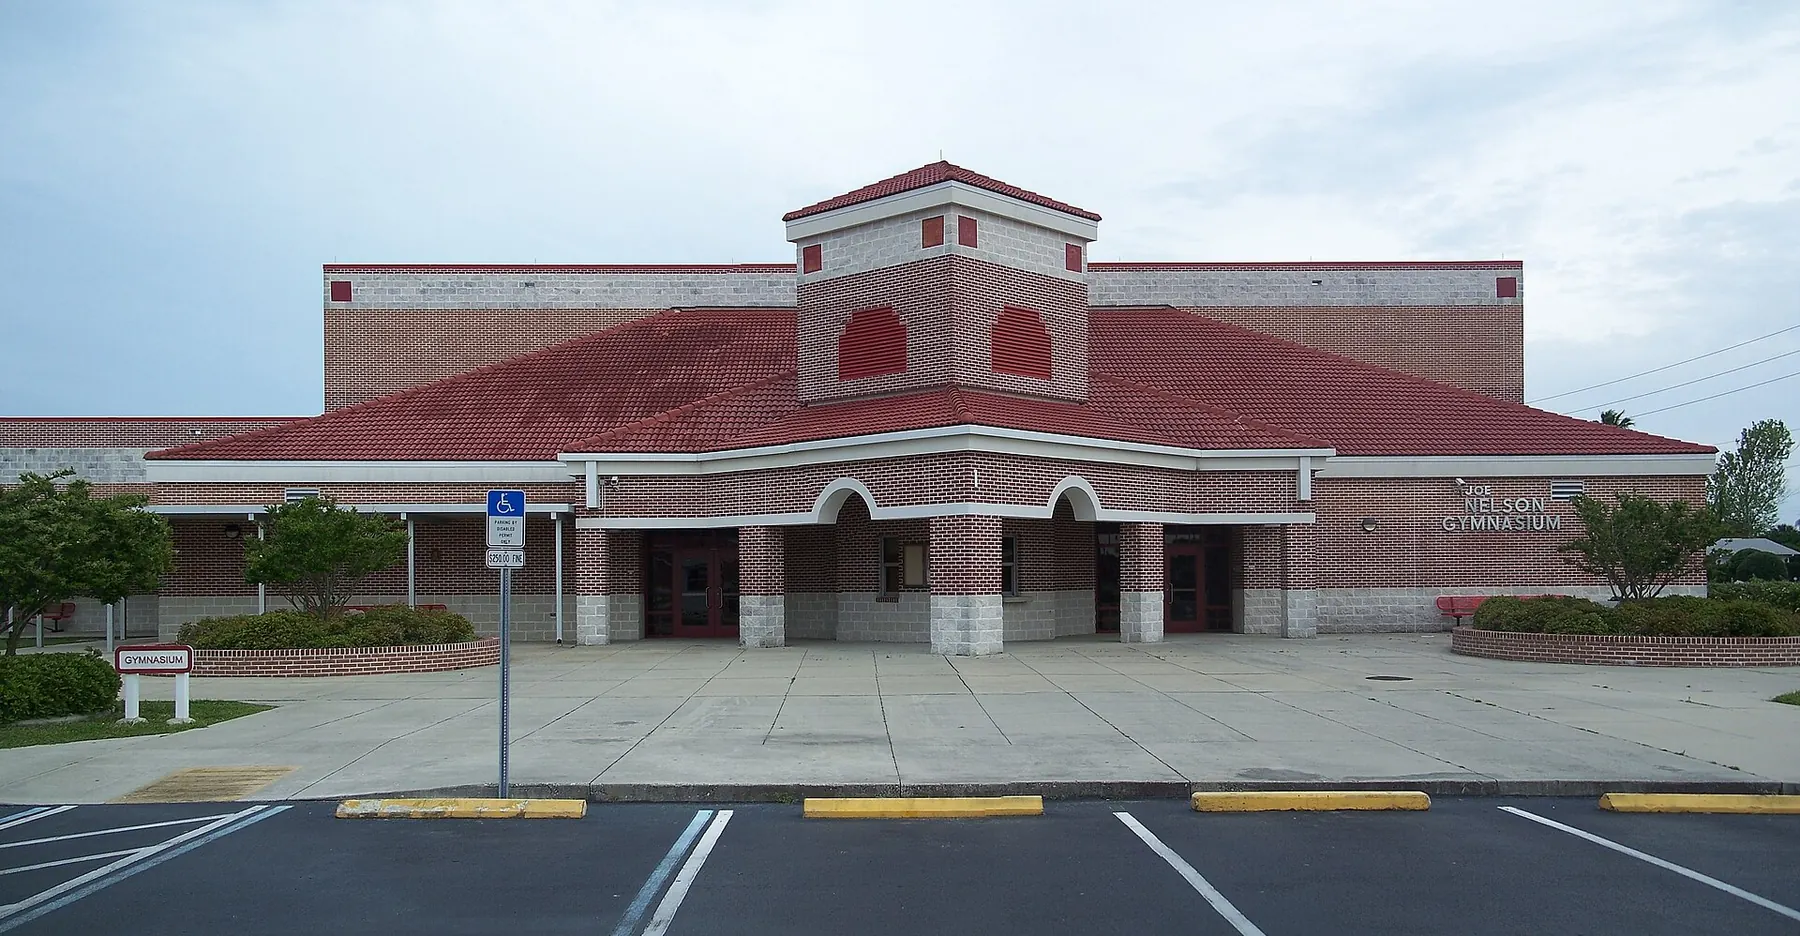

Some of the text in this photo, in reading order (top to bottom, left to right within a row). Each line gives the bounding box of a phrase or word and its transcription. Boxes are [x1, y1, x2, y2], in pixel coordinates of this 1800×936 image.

[1465, 485, 1492, 496] JOE
[1464, 498, 1545, 513] NELSON
[1442, 515, 1561, 531] GYMNASIUM
[512, 554, 523, 563] FINE
[124, 655, 184, 665] GYMNASIUM
